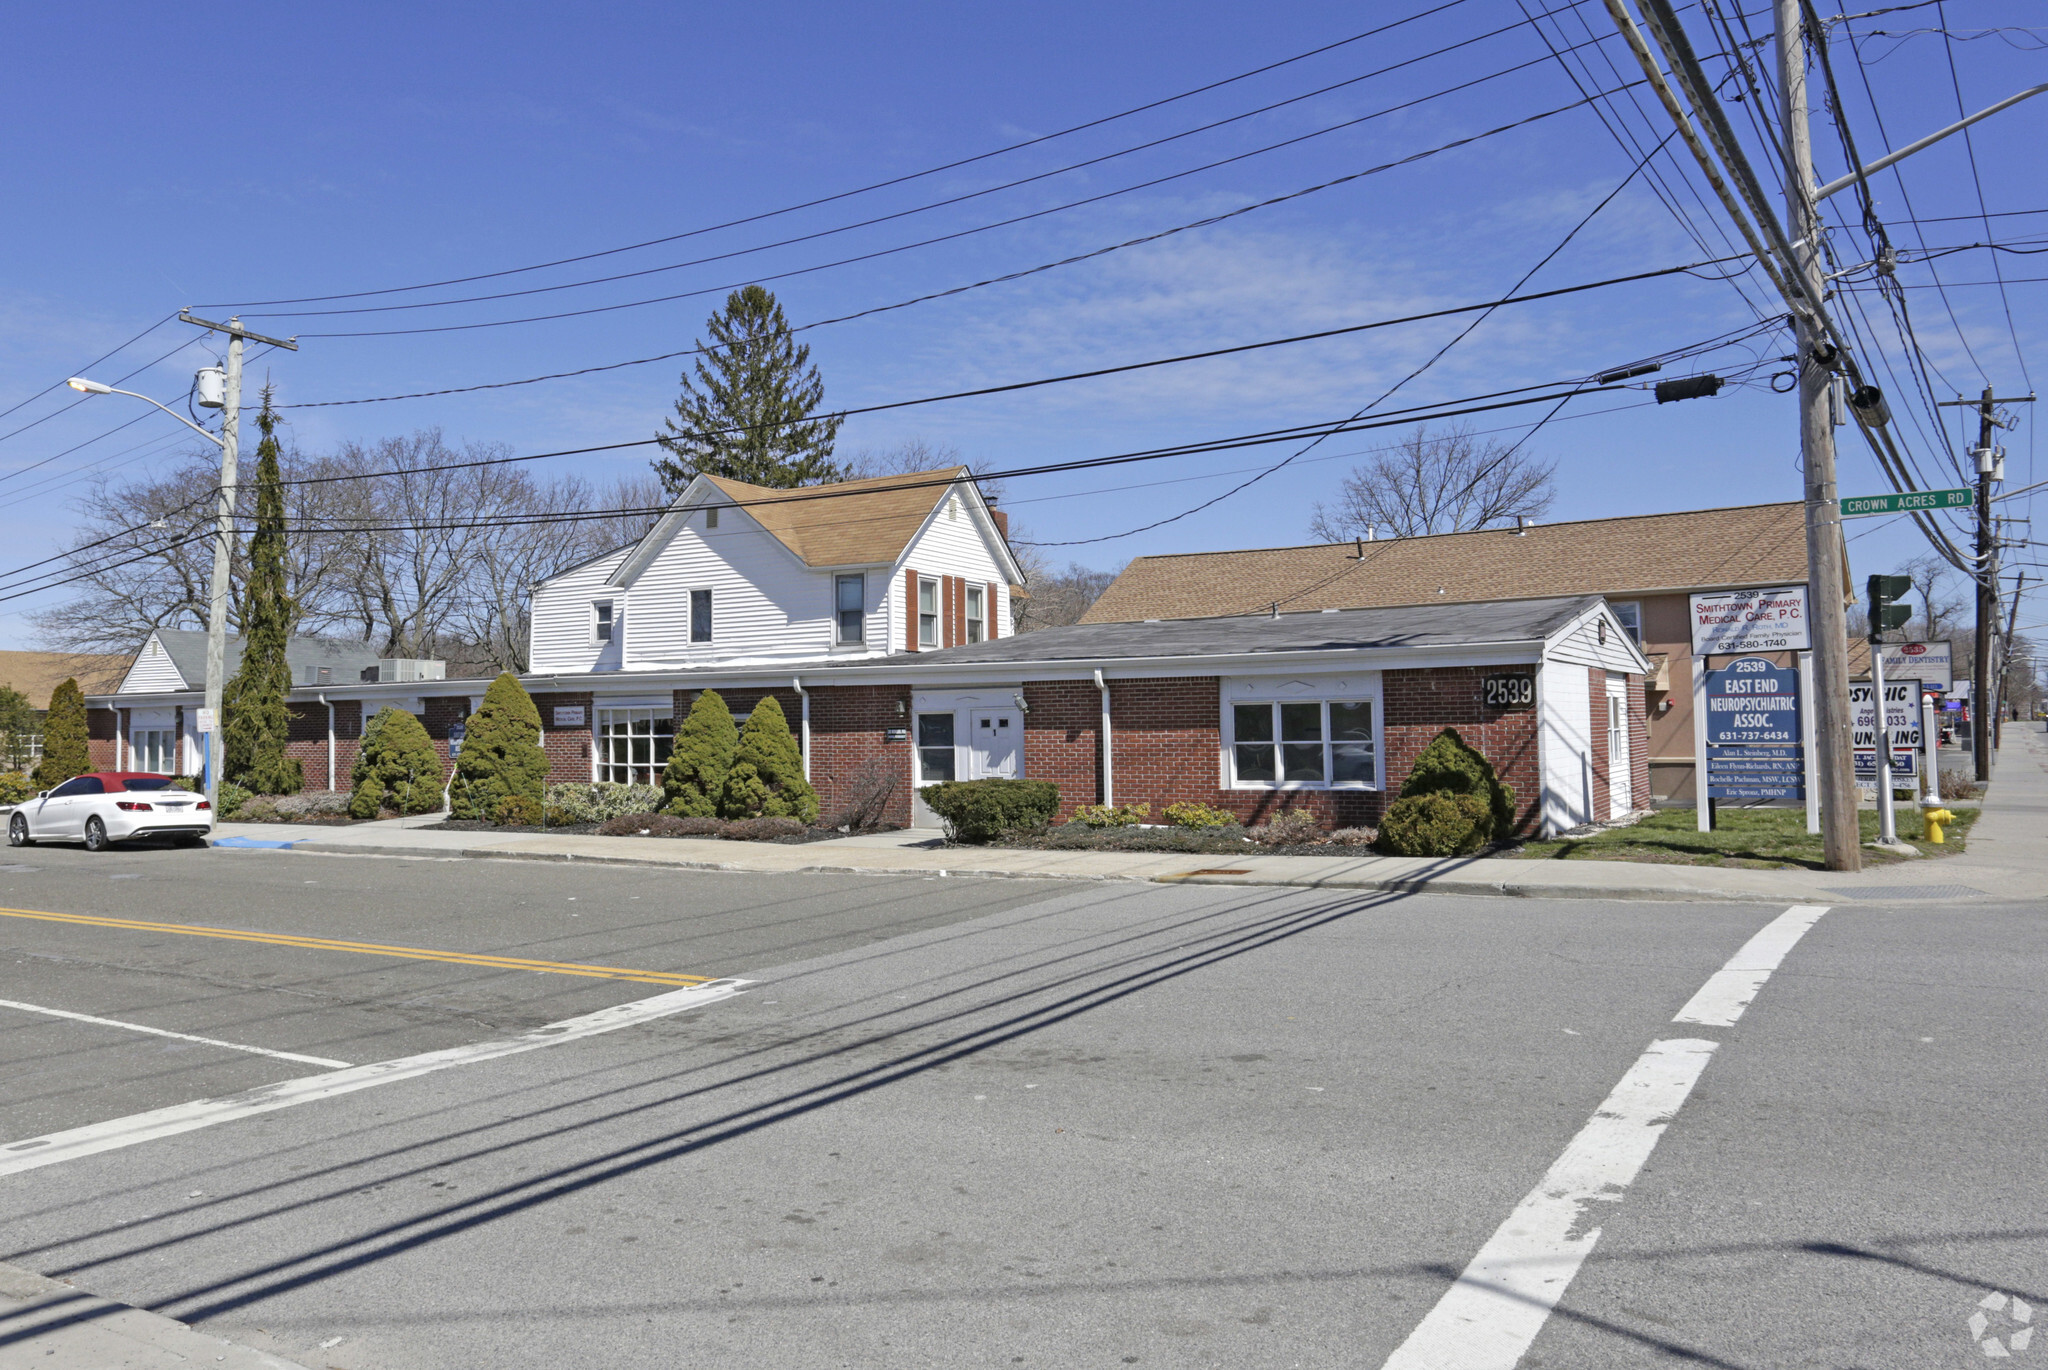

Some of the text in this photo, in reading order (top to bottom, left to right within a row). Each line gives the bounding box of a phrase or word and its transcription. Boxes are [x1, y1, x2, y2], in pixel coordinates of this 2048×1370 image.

[1848, 492, 1964, 512] CROWN ACRES RD
[1734, 591, 1759, 600] 2539
[1696, 599, 1802, 614] SMITHTOWN PRIMARY
[1699, 614, 1741, 625] MEDICAL
[1779, 608, 1802, 619] P.C.
[1772, 630, 1802, 639] Physician
[1718, 638, 1787, 650] 631-580-1740
[1908, 655, 1949, 664] DENTISTRY
[1736, 661, 1766, 673] 2539
[1487, 678, 1532, 704] 2539
[1725, 679, 1778, 694] EAST END
[1710, 697, 1795, 711] NEUROPSYCHIATRIC
[1733, 713, 1773, 728] ASSOC.
[1719, 731, 1789, 740] 631-737-6434
[1722, 749, 1736, 757] Alan
[1772, 749, 1787, 757] M.D.
[1710, 775, 1733, 783] Rochelle
[1762, 775, 1781, 783] MSW,
[1726, 788, 1739, 796] Eric
[1761, 788, 1786, 796] PMHNP
